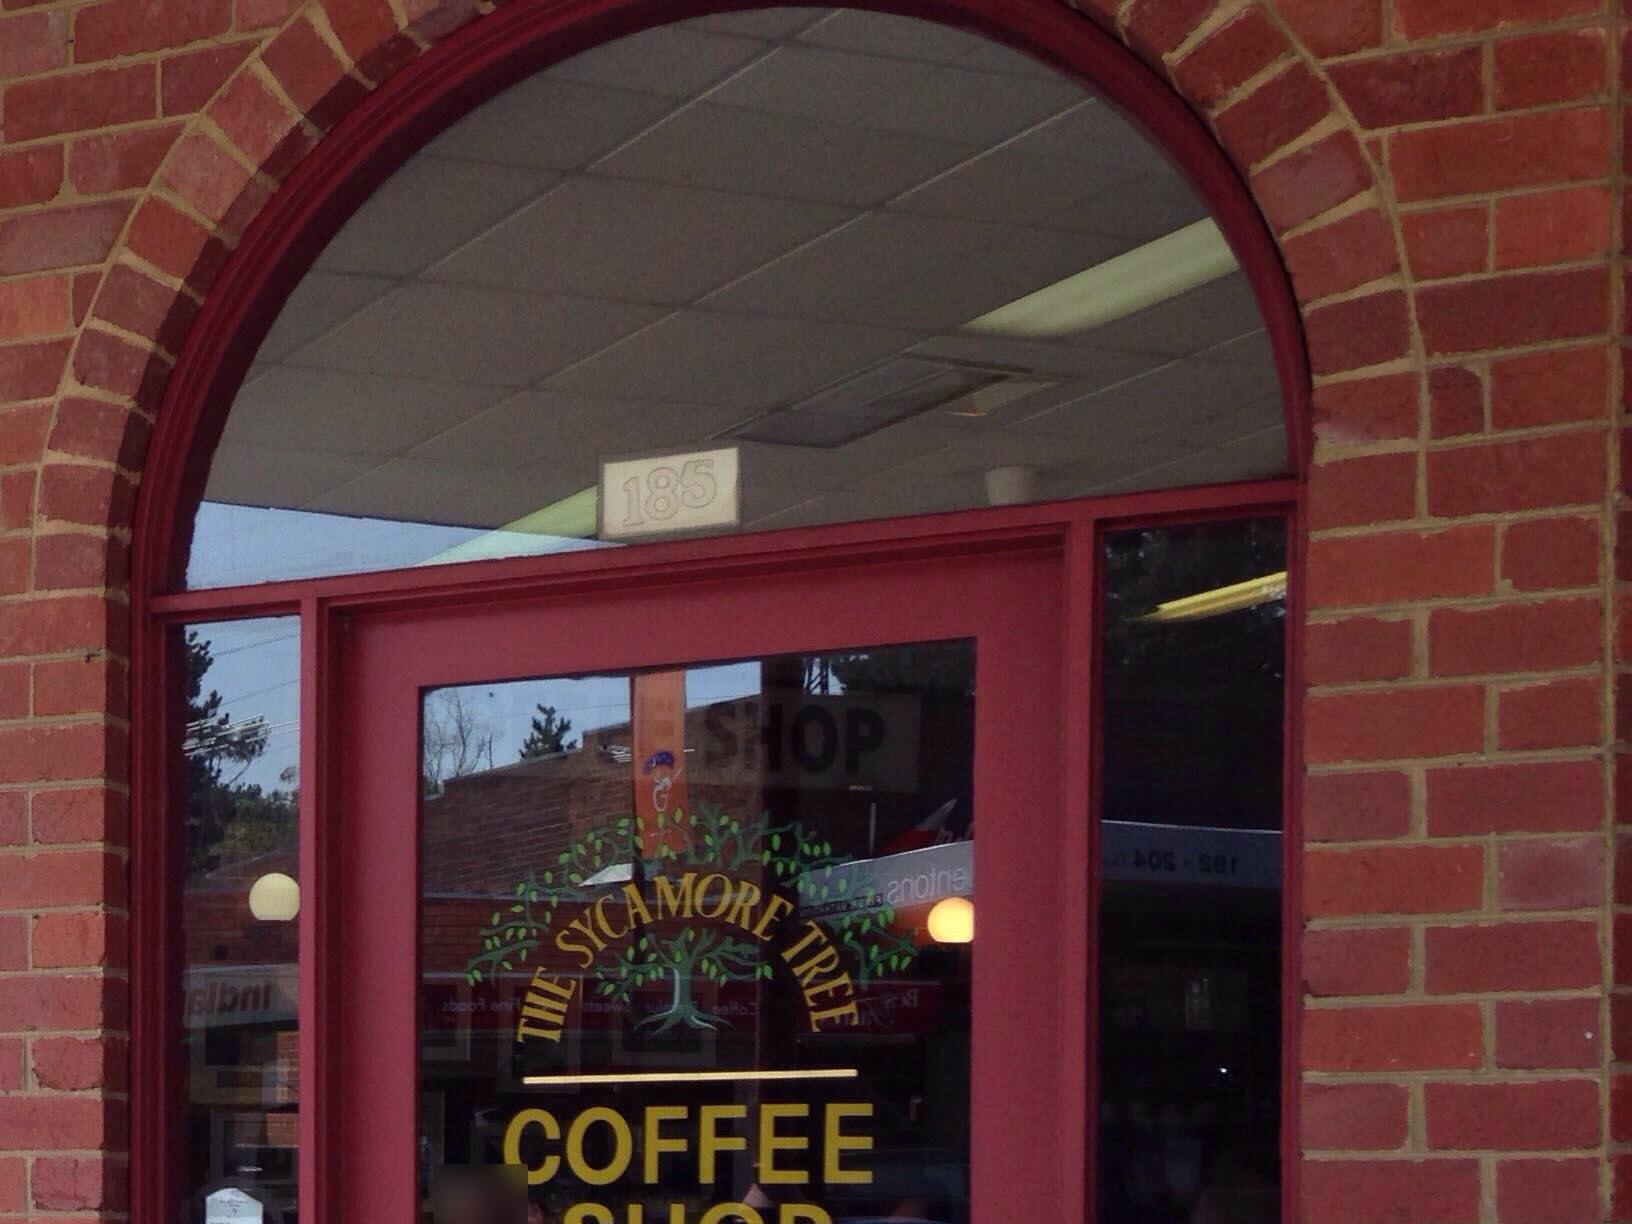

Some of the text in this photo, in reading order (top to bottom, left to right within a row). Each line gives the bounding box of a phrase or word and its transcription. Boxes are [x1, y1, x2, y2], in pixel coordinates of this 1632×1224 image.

[622, 458, 717, 527] 185
[517, 965, 580, 1044] THE
[555, 872, 795, 970] SYCAMORE
[780, 920, 859, 1033] TREE
[503, 1103, 873, 1186] COFFEE
